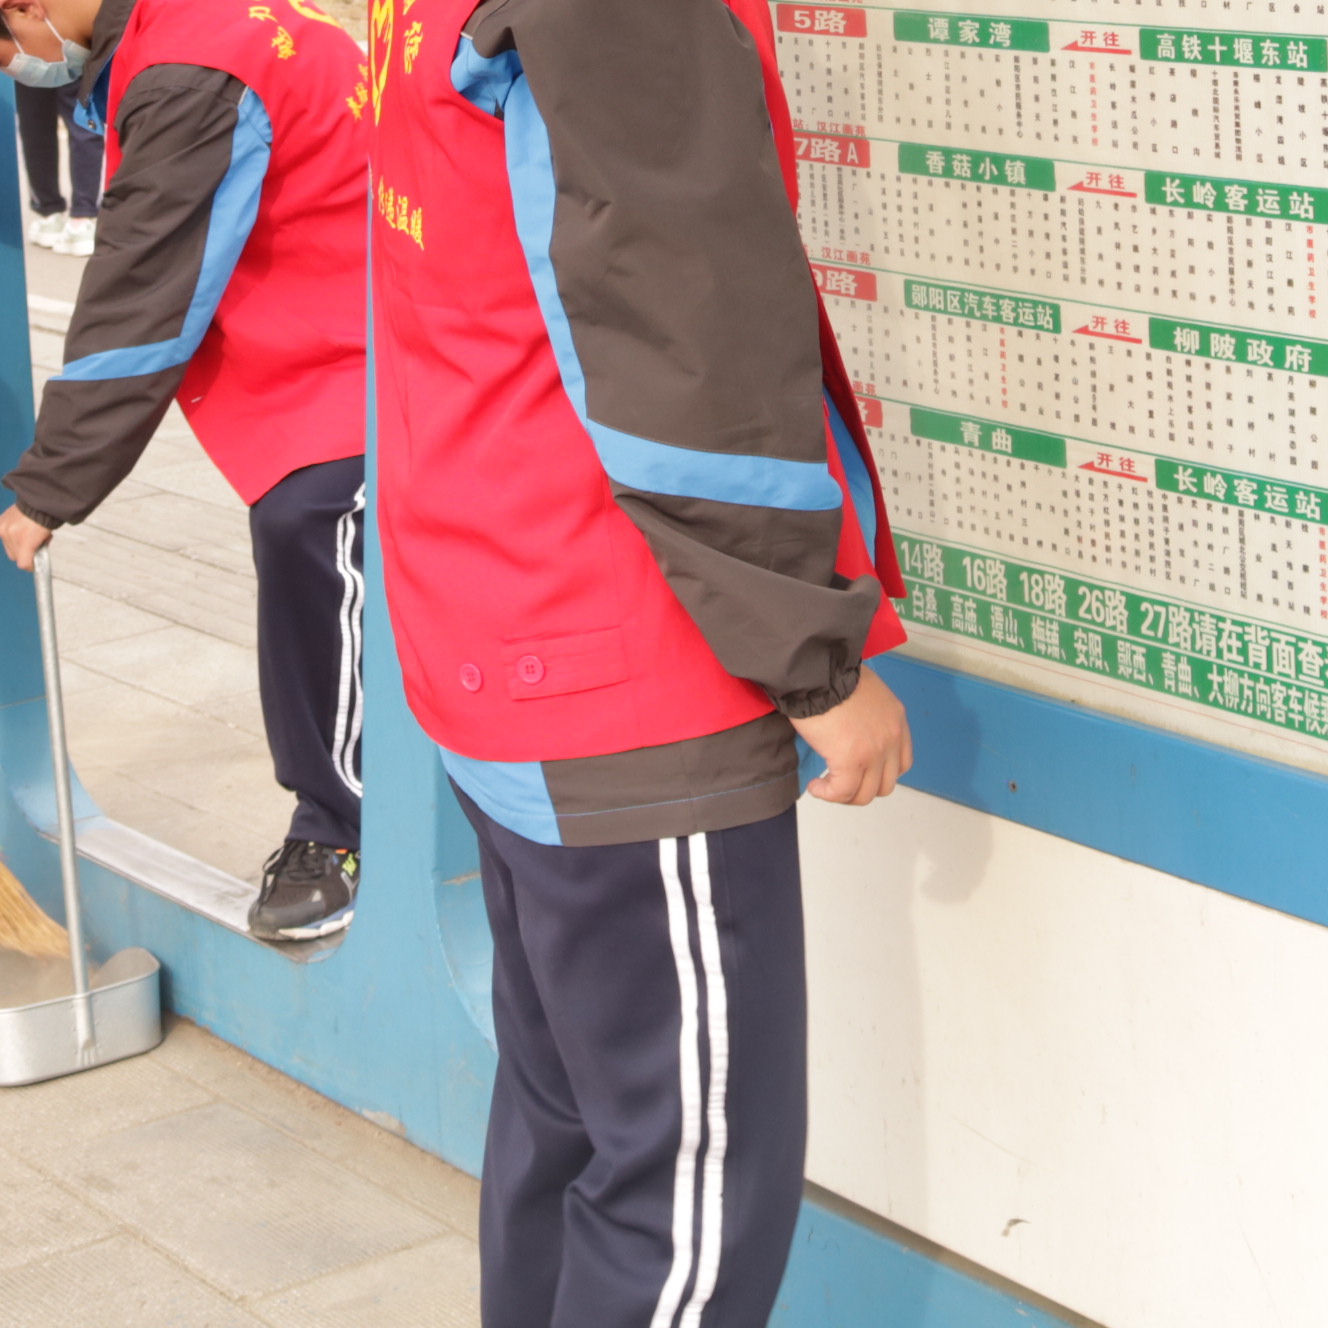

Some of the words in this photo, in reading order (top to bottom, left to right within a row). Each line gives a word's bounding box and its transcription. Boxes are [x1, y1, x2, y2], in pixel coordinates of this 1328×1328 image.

[794, 10, 847, 34] 5路
[928, 17, 1012, 48] 谭家湾
[1080, 30, 1120, 47] 开往
[1156, 33, 1308, 68] 高铁十堰东站
[926, 151, 1026, 184] 香菇小镇
[1086, 172, 1125, 190] 开往
[1162, 177, 1314, 220] 长岭客运站
[912, 284, 1054, 330] 郧阳区汽车客运站
[1092, 316, 1130, 335] 开往
[1174, 326, 1312, 372] 柳陂政府
[961, 422, 1012, 453] 青曲
[1096, 452, 1136, 473] 开往
[1174, 466, 1322, 520] 长岭客运站
[901, 541, 944, 585] 14路
[963, 556, 1007, 602] 16路
[1020, 572, 1067, 618] 18路
[1078, 586, 1128, 635] 26路
